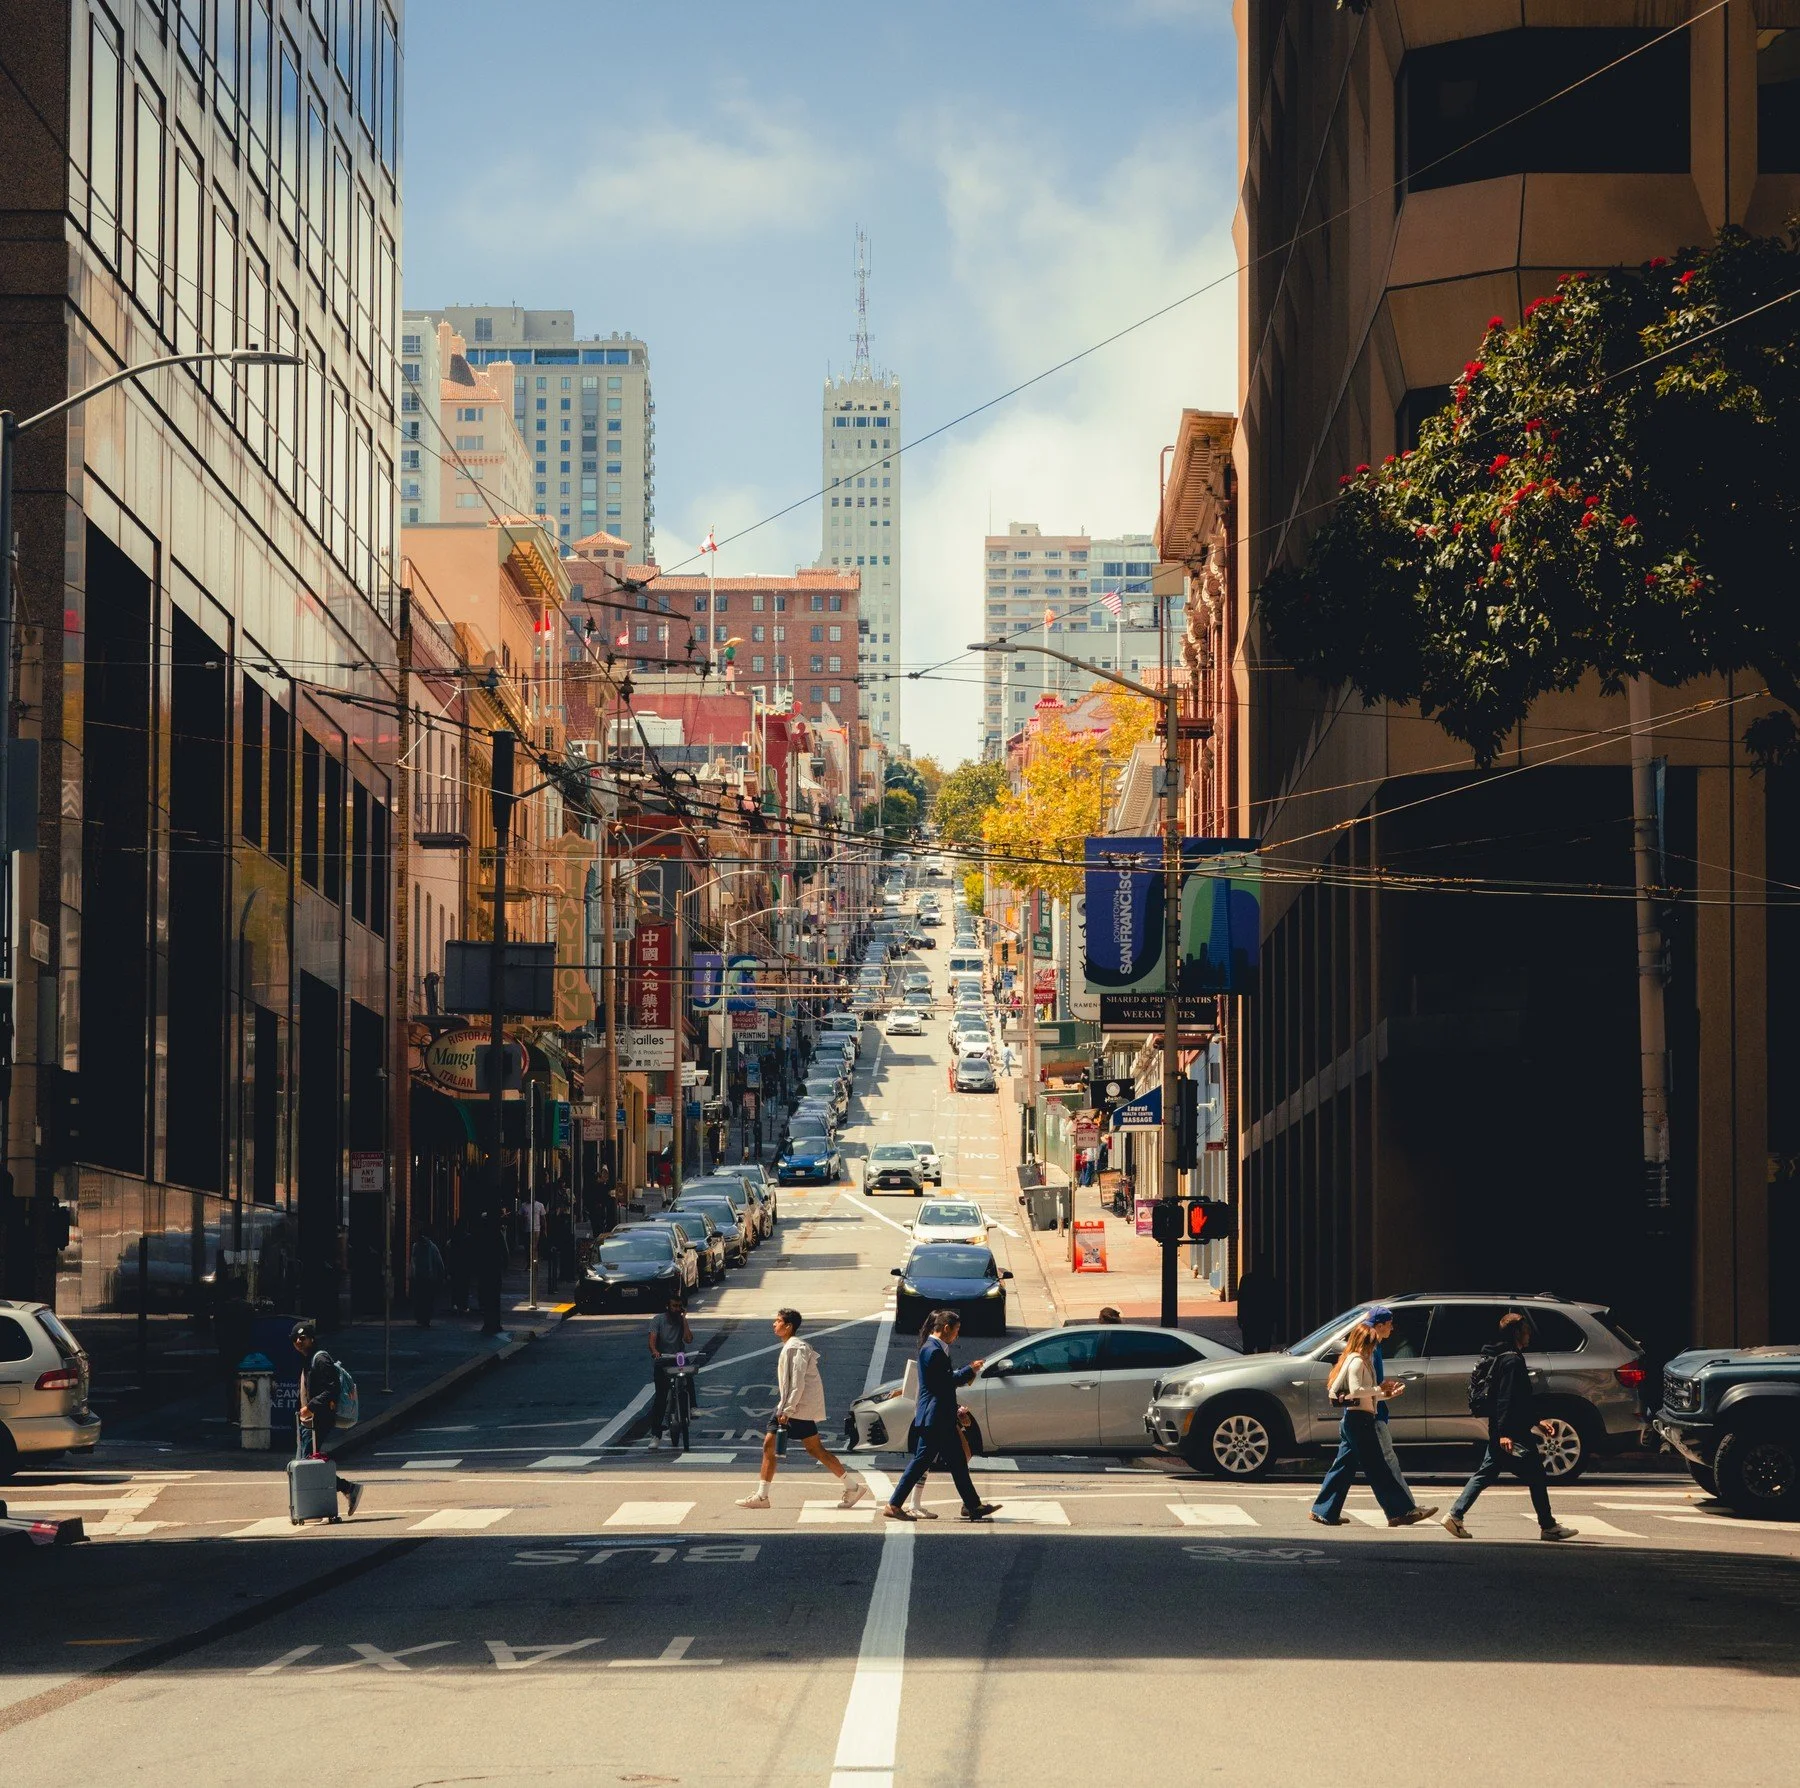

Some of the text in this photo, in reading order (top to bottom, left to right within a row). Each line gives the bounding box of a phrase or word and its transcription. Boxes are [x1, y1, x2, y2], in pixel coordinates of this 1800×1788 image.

[558, 844, 580, 1016] CLAYTON
[1123, 1010, 1196, 1018] WEEKLY TES
[447, 1030, 492, 1045] RISTORA
[614, 1034, 664, 1045] vesailles
[739, 1031, 766, 1039] PRINTING
[432, 1047, 477, 1070] Mangi
[439, 1069, 473, 1087] ITALIAN
[360, 1176, 376, 1184] TIME
[276, 1389, 300, 1399] CAN
[286, 1399, 298, 1408] IT
[506, 1544, 762, 1566] BUS
[247, 1636, 723, 1676] TAXI
